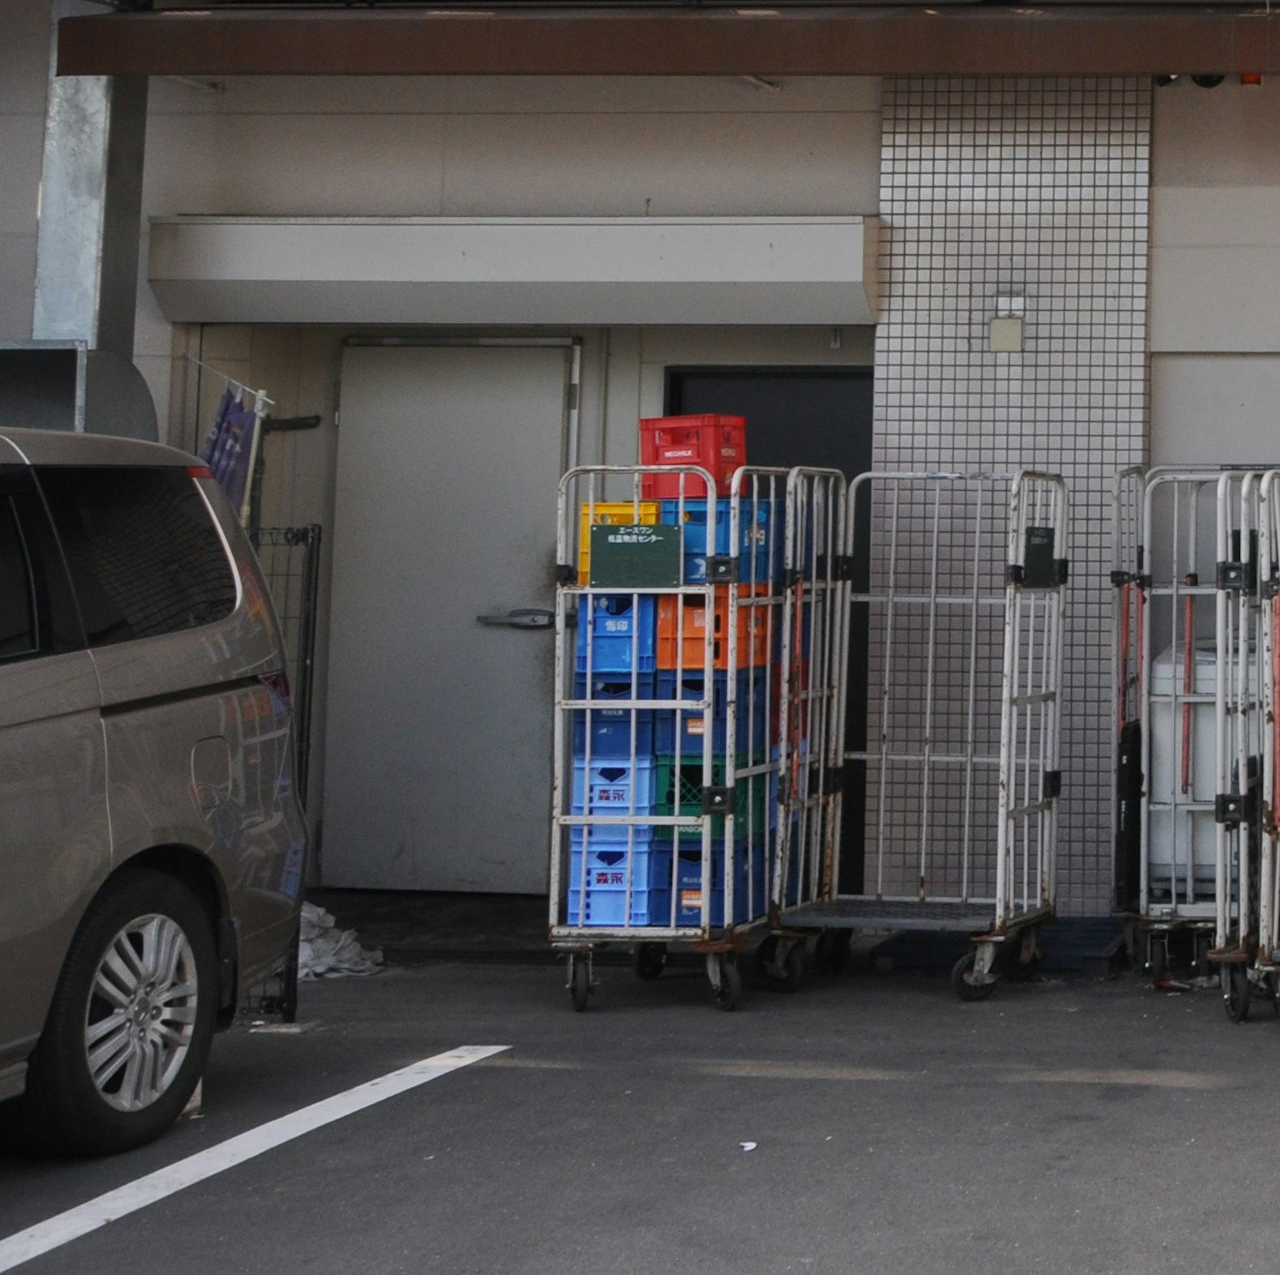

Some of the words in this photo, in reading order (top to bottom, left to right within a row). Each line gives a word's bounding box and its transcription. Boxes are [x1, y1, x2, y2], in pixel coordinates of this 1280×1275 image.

[618, 526, 654, 534] エースワン
[597, 789, 626, 802] 森永
[595, 872, 625, 885] 森永
